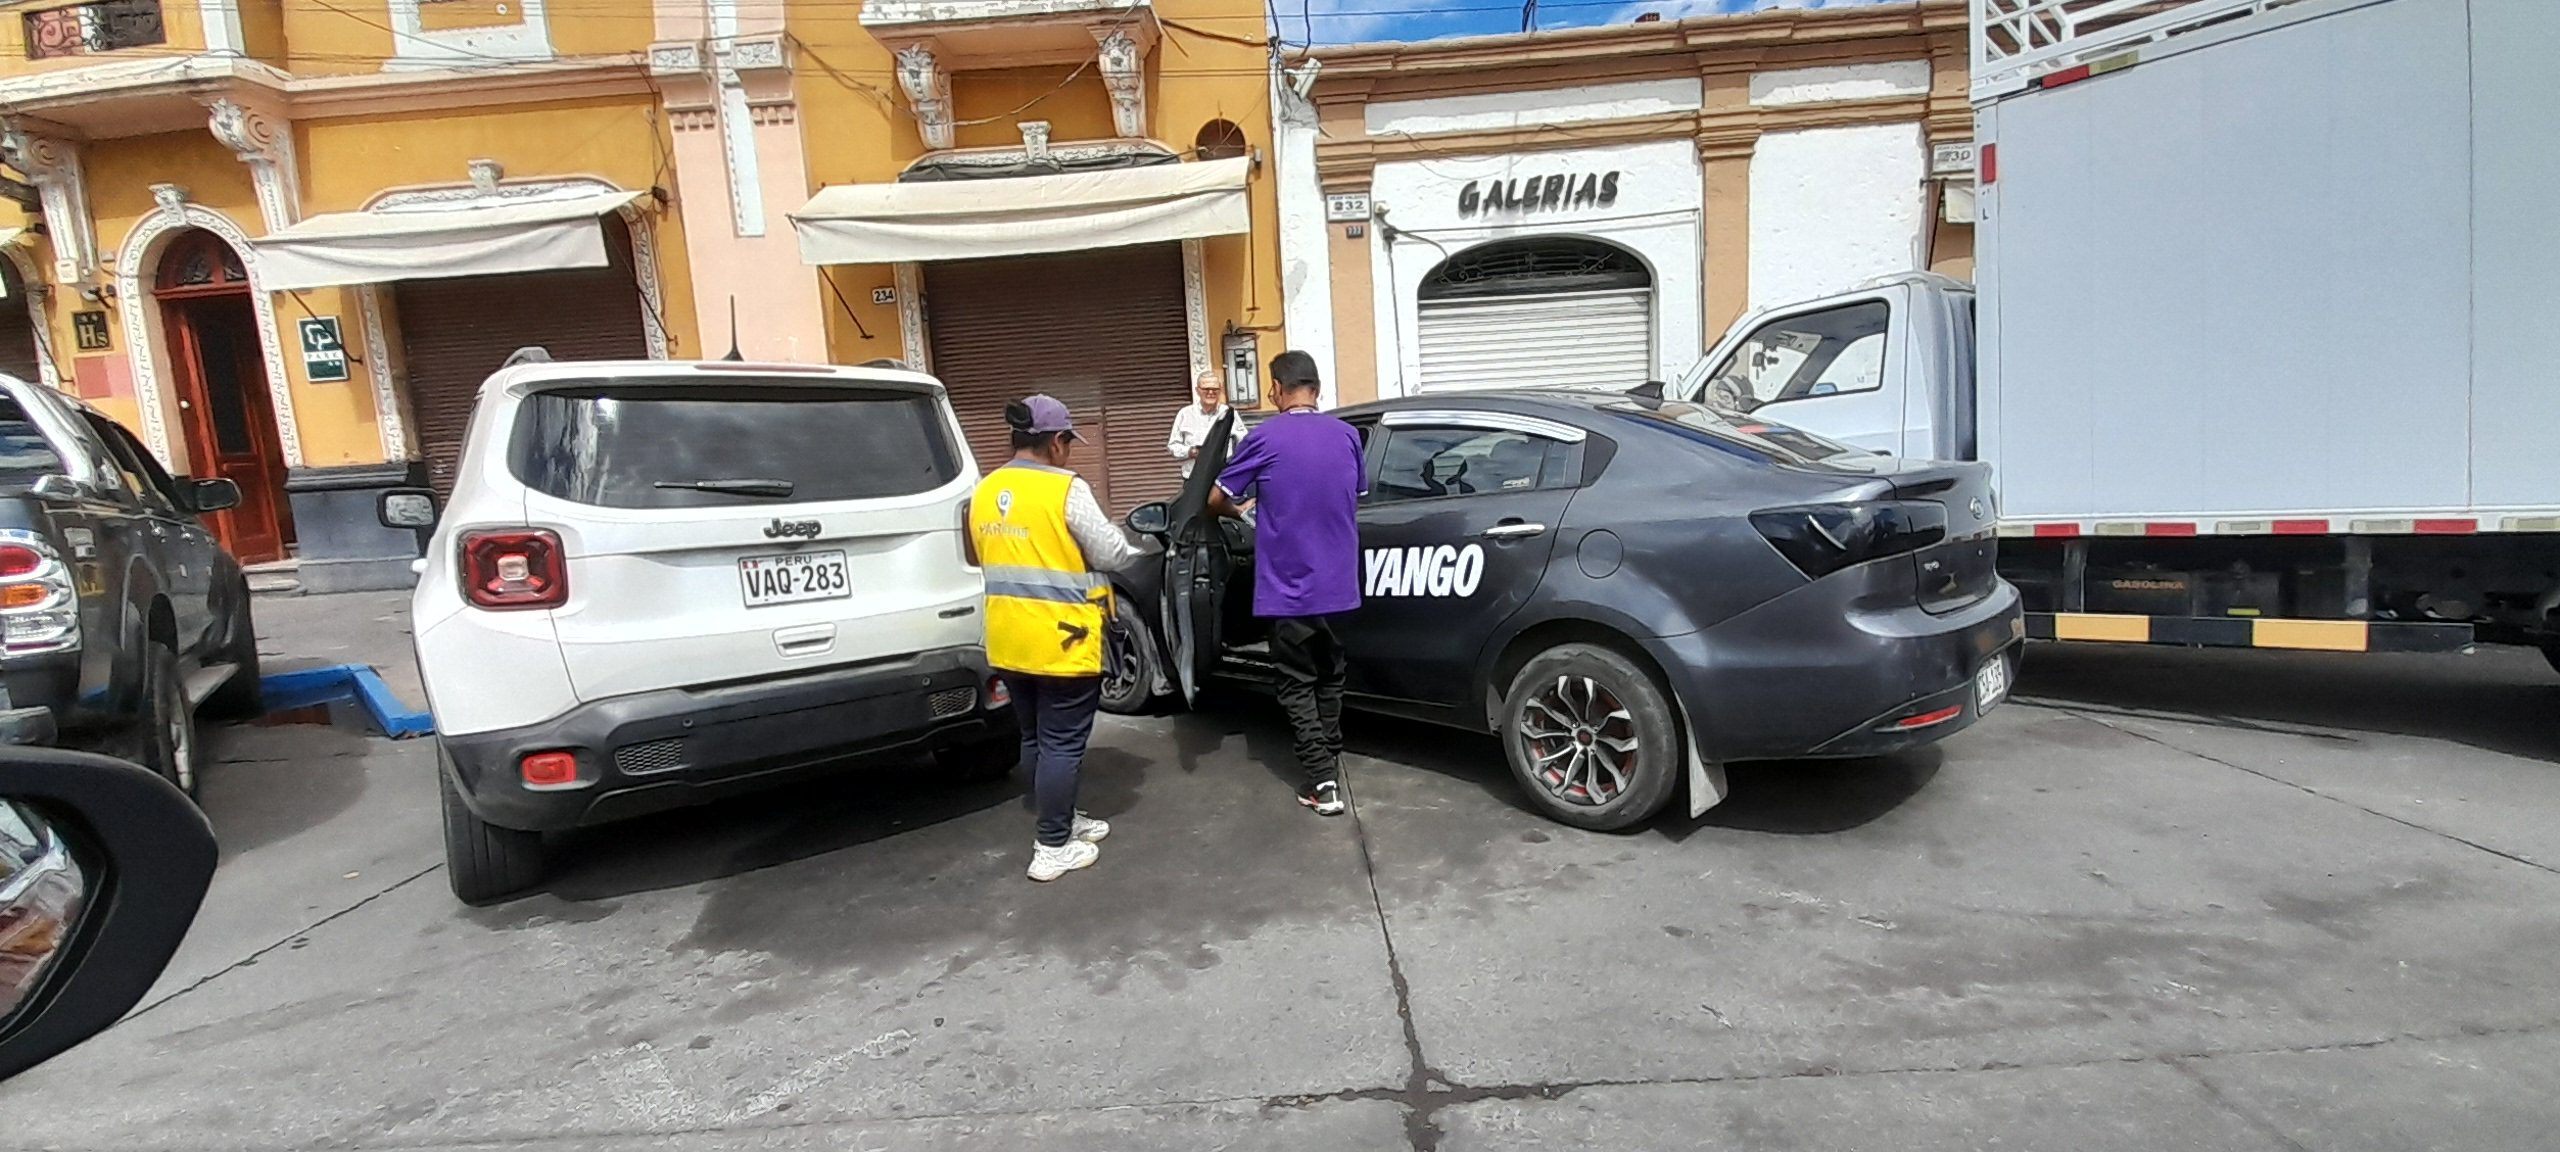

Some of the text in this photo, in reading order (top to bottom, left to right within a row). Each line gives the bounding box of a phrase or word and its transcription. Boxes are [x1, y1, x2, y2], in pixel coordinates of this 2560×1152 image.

[1458, 171, 1620, 217] GALERIAS
[874, 290, 894, 302] 234
[78, 324, 108, 347] Hs
[763, 517, 822, 539] Jeep
[775, 555, 812, 566] PERU
[1364, 543, 1485, 598] YANGO
[746, 562, 845, 598] VAQ-283
